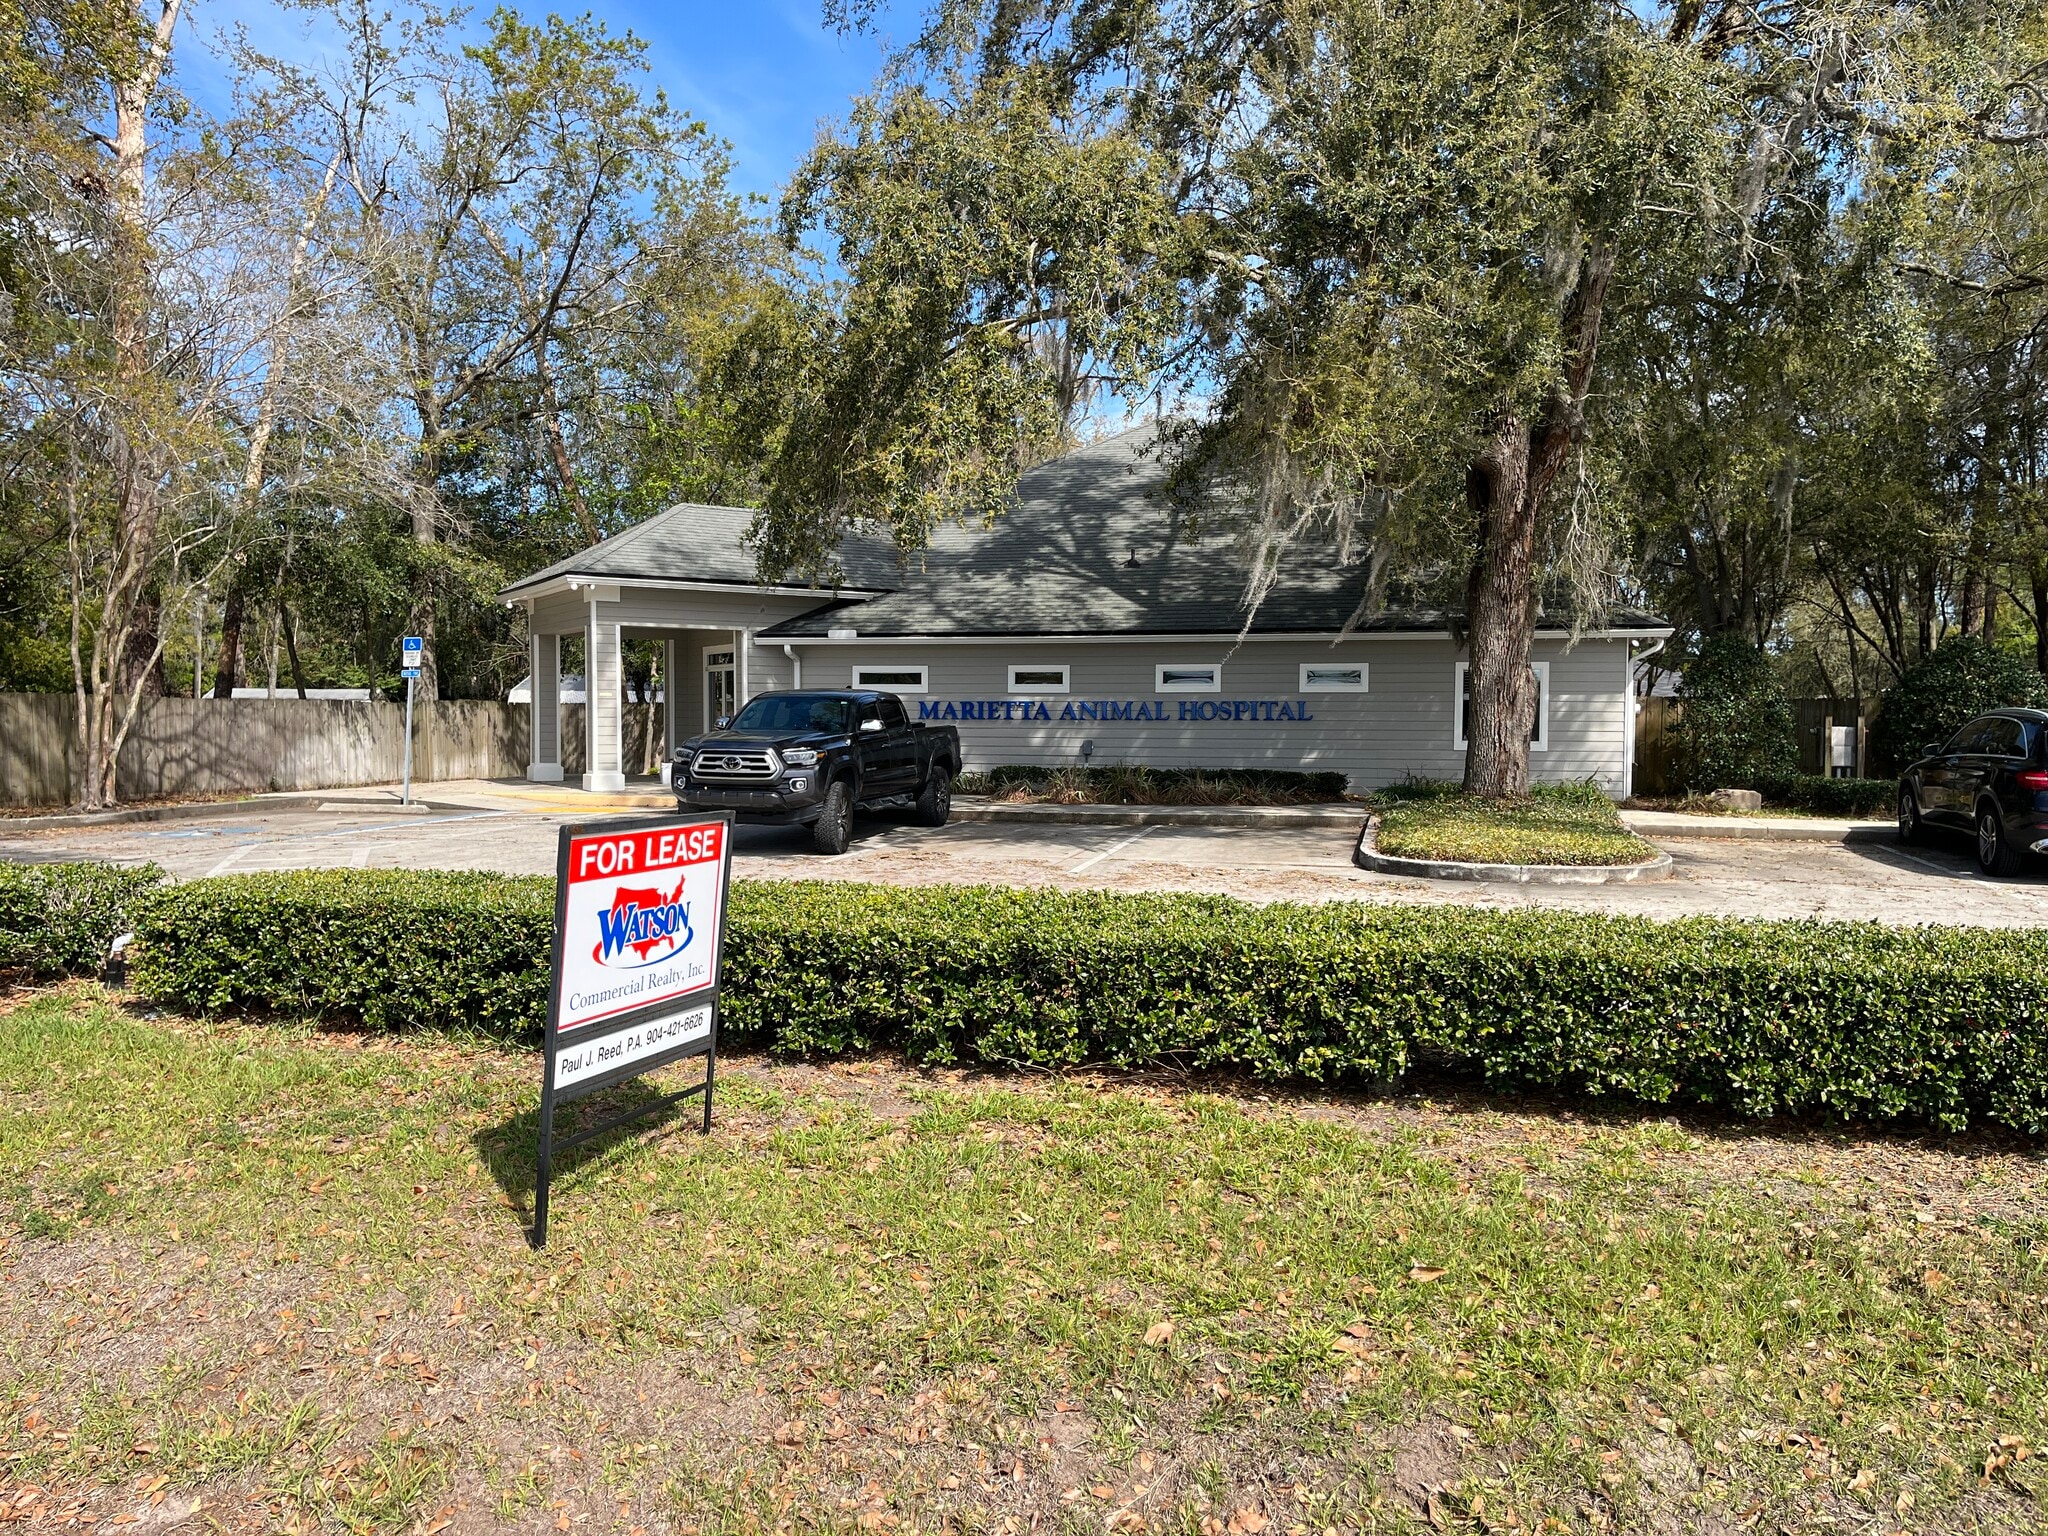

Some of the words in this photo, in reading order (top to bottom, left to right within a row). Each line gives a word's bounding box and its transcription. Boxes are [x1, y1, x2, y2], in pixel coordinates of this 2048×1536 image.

[918, 701, 1052, 720] MARIETTA
[1059, 701, 1170, 720] ANIMAL
[1177, 701, 1313, 721] HOSPITAL
[580, 840, 635, 877] FOR
[645, 829, 716, 867] LEASE
[597, 901, 691, 960] WATSON
[569, 976, 644, 1011] Commercial
[647, 968, 685, 988] Realty,
[687, 962, 705, 978] Inc.
[561, 1053, 582, 1075] Paul
[585, 1050, 594, 1066] J.
[597, 1041, 623, 1063] Reed,
[626, 1034, 643, 1053] P.A.
[646, 1012, 704, 1046] 904-421-6626
